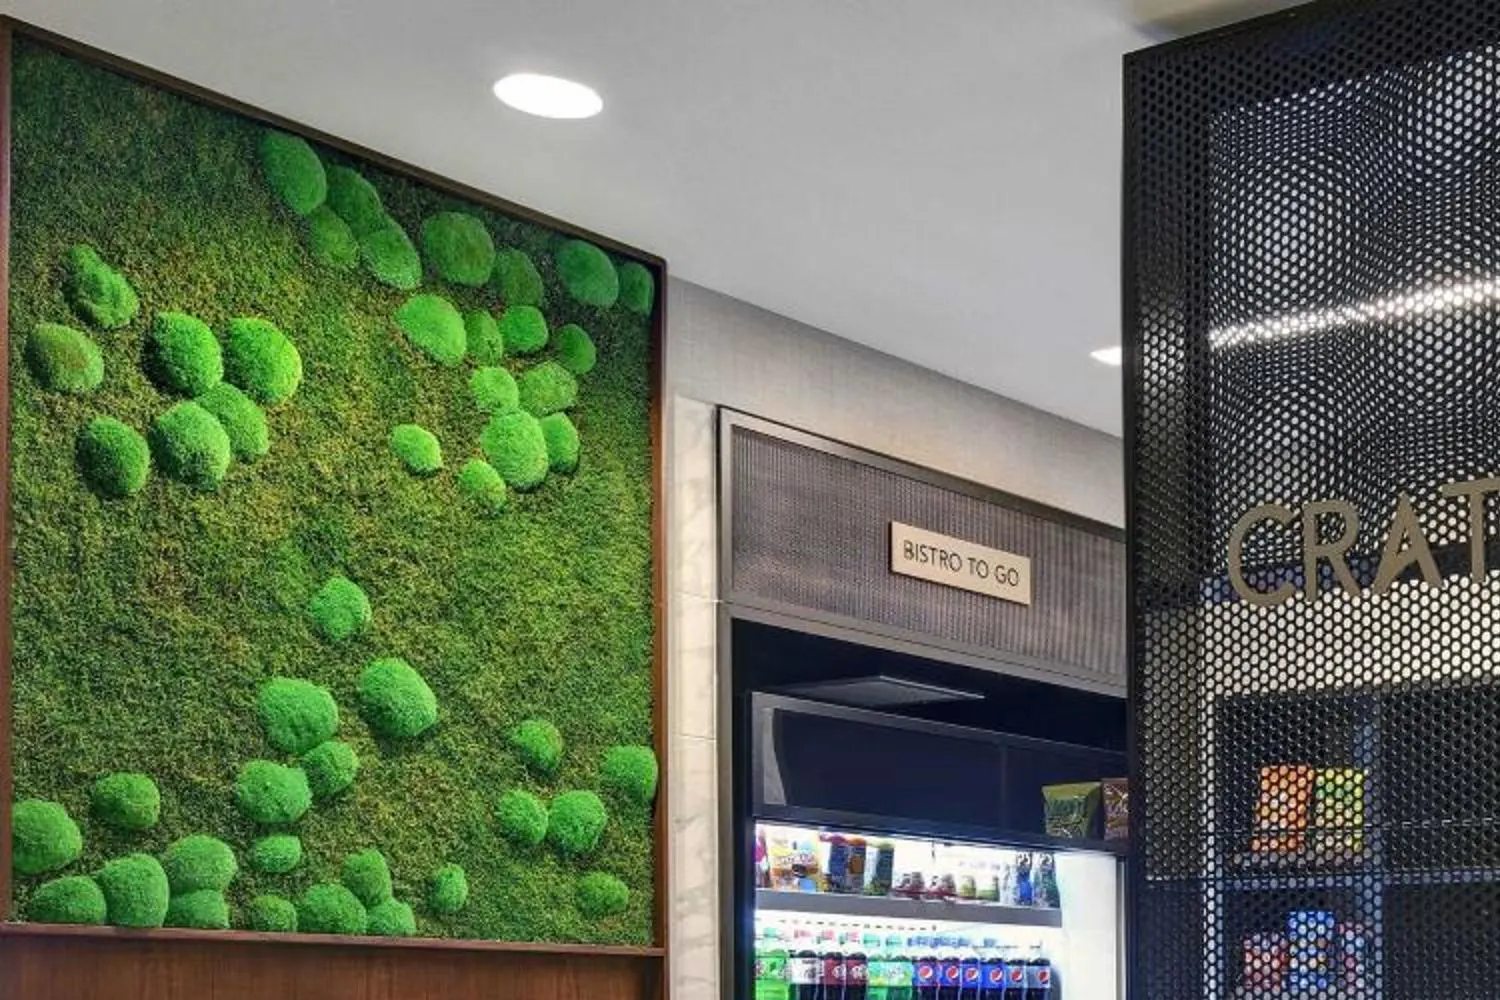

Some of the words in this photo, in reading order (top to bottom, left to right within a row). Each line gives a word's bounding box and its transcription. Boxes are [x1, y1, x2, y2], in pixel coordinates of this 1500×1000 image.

[903, 540, 963, 573] BISTRO
[967, 557, 989, 579] TO
[994, 565, 1019, 587] GO
